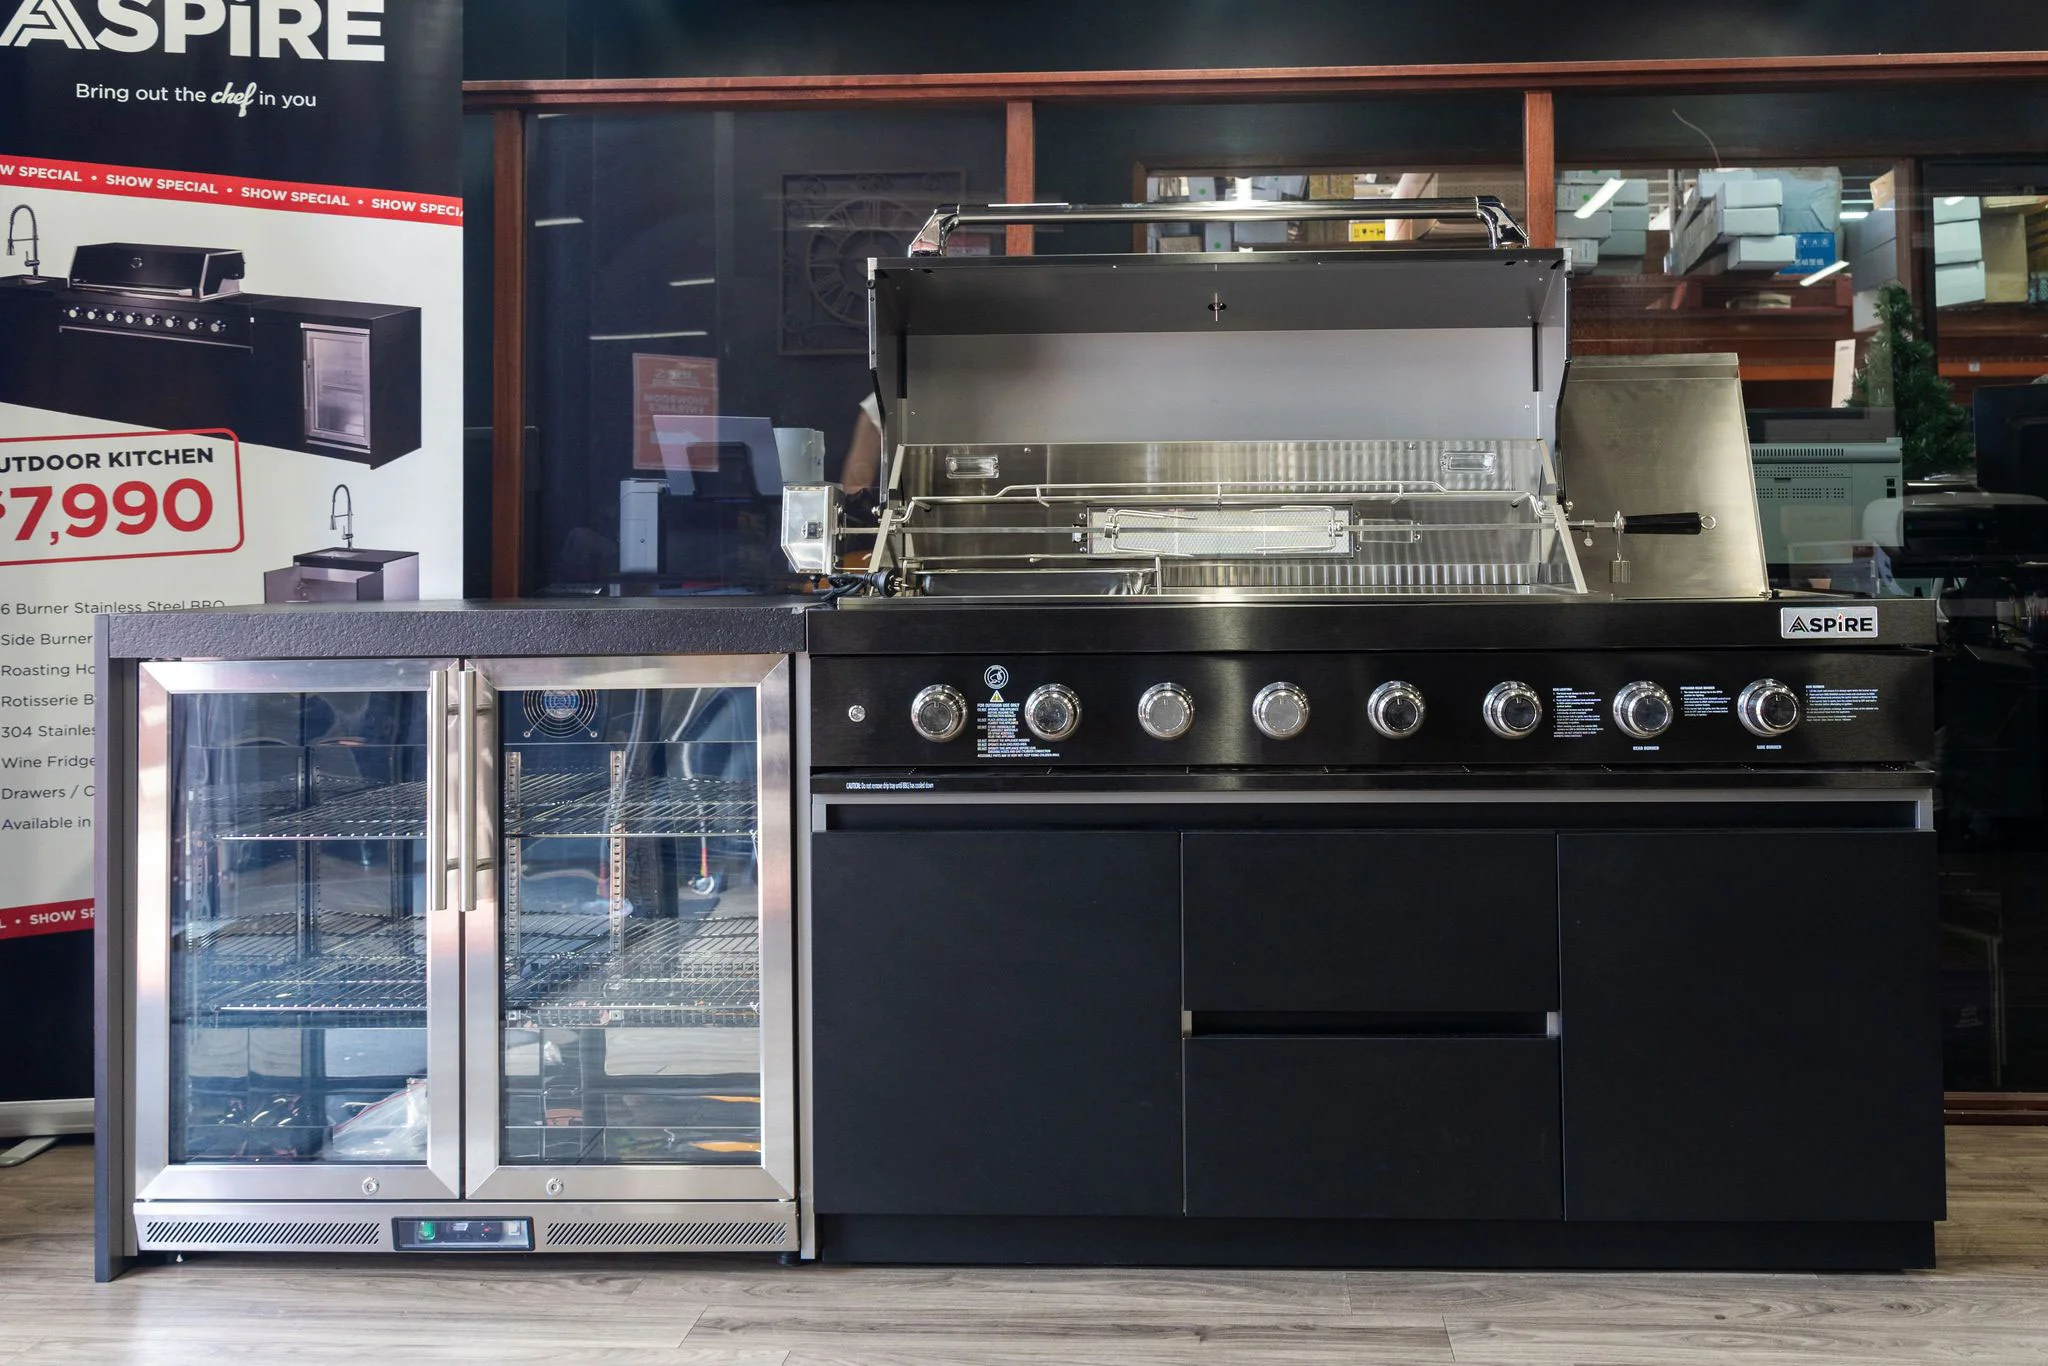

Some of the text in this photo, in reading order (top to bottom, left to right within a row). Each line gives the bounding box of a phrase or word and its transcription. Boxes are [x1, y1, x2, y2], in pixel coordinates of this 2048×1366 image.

[76, 82, 317, 117] Bring out the chef in you
[18, 166, 83, 182] SPECIAL
[106, 174, 153, 189] SHOW
[156, 178, 219, 195] SPECIAL
[241, 186, 288, 201] SHOW
[290, 191, 350, 206] SPECIAL
[371, 198, 416, 212] SHOW
[108, 447, 214, 468] KITCHEN
[0, 604, 11, 615] 6
[16, 603, 69, 615] Burner
[74, 602, 142, 615] Stainless
[147, 600, 186, 612] Steel
[1, 633, 94, 646] Side Burner
[1, 664, 70, 678] Roasting
[1, 695, 79, 708] Rotisserie
[1, 726, 32, 739] 304
[1, 755, 96, 769] Wine Fridge
[1, 788, 66, 800] Drawers
[1, 816, 92, 830] Available in
[29, 910, 77, 925] SHOW
